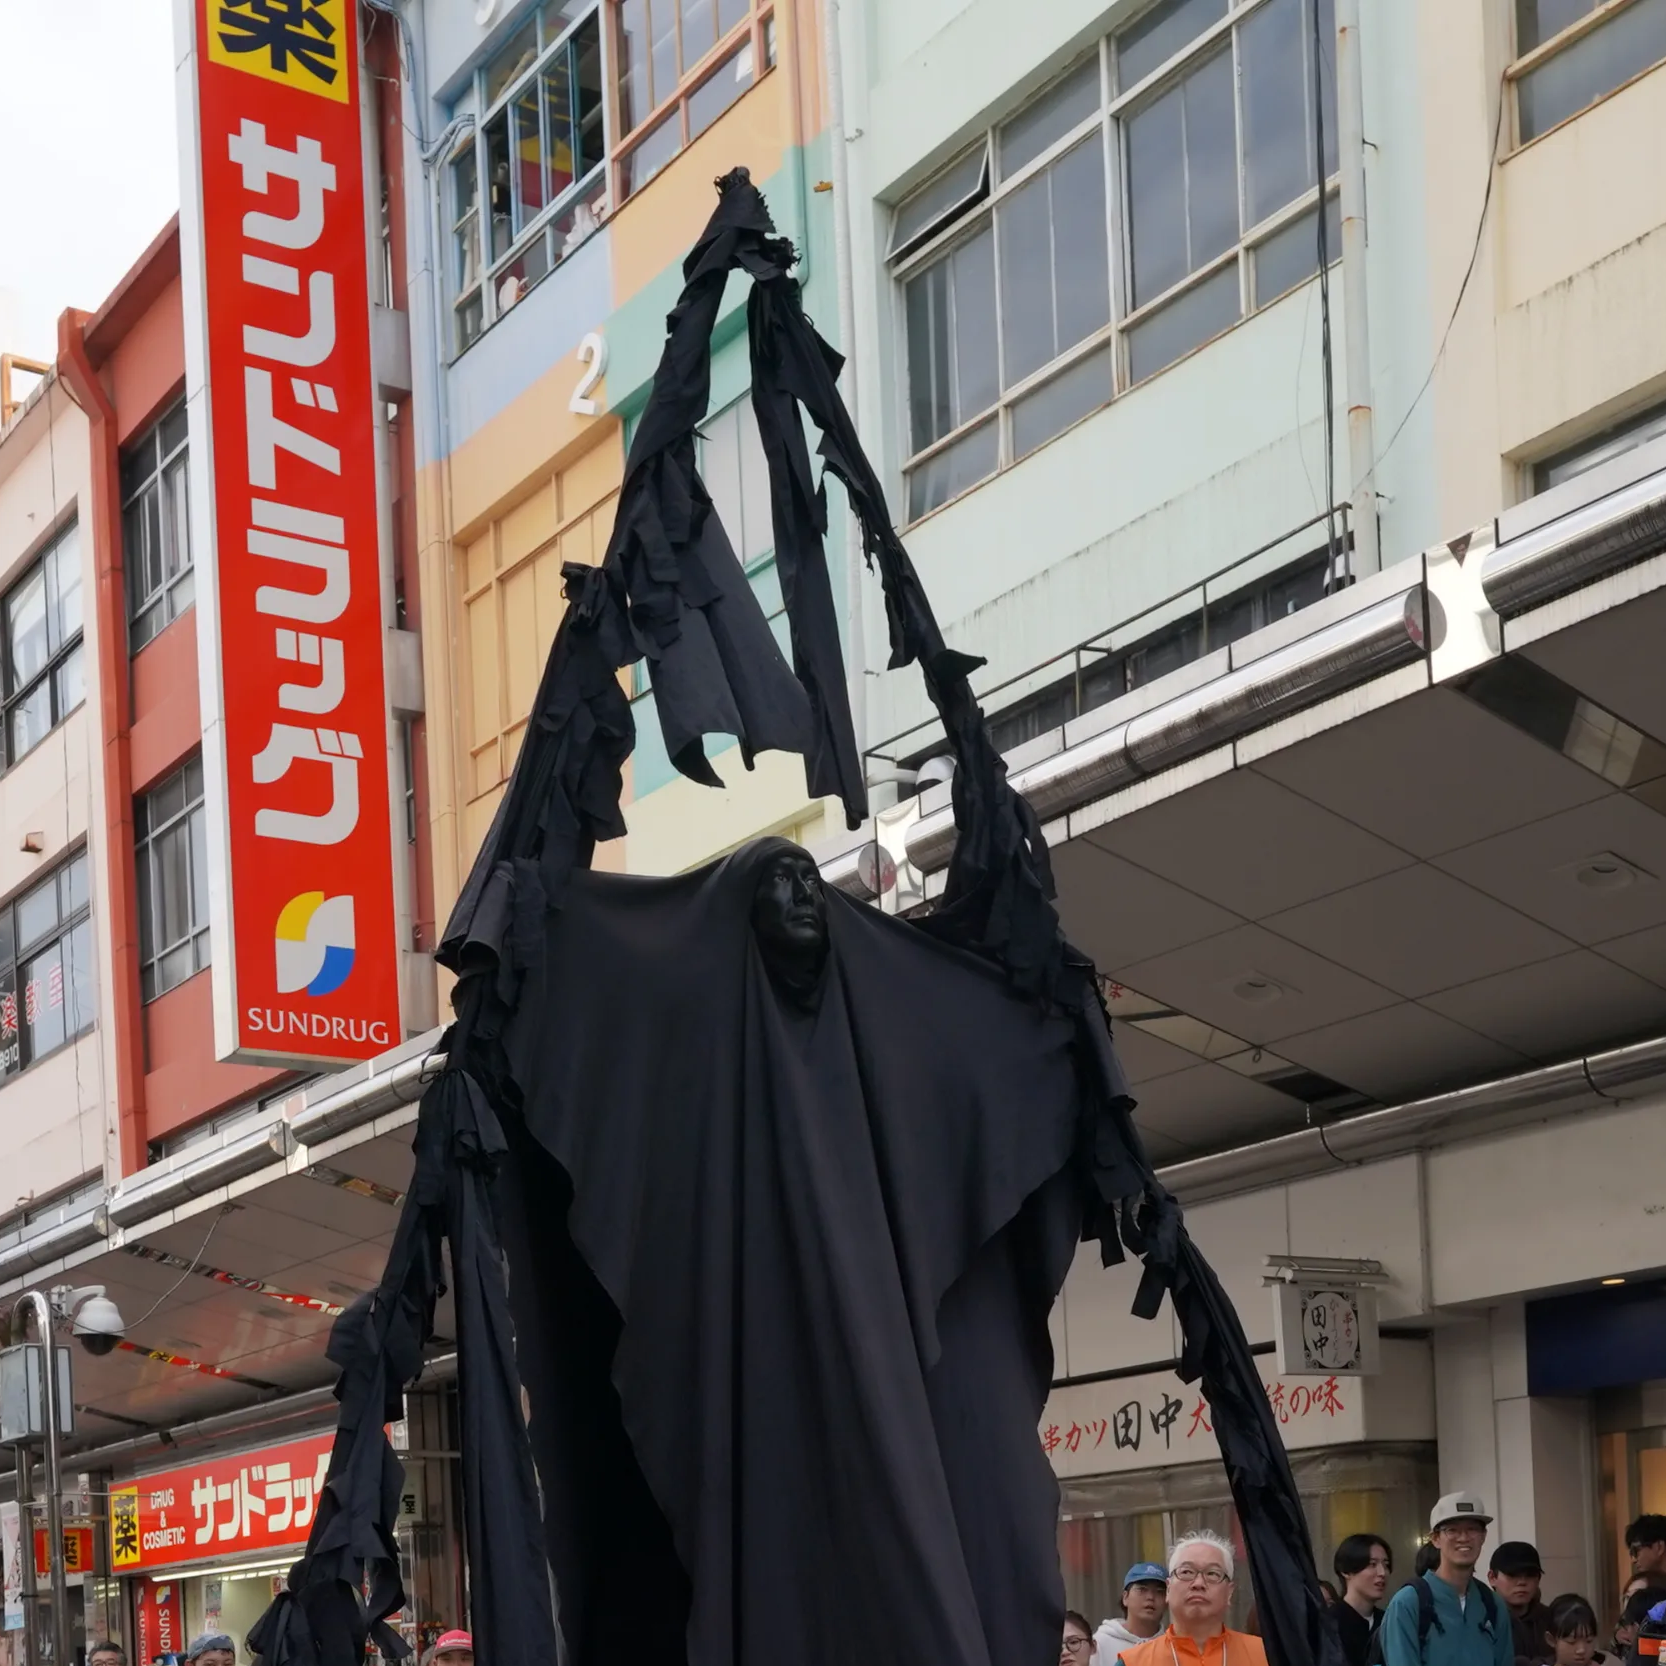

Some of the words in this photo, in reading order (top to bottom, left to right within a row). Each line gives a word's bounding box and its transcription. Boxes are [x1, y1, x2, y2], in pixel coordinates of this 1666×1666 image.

[569, 332, 608, 416] 2
[228, 117, 364, 845] サンドラッグ
[247, 1007, 389, 1045] SUNDRUG
[1311, 1304, 1329, 1359] 田中
[1187, 1375, 1345, 1438] 大統の味
[150, 1488, 175, 1509] DRUG
[159, 1510, 168, 1529] &
[143, 1526, 186, 1550] COSMETIC
